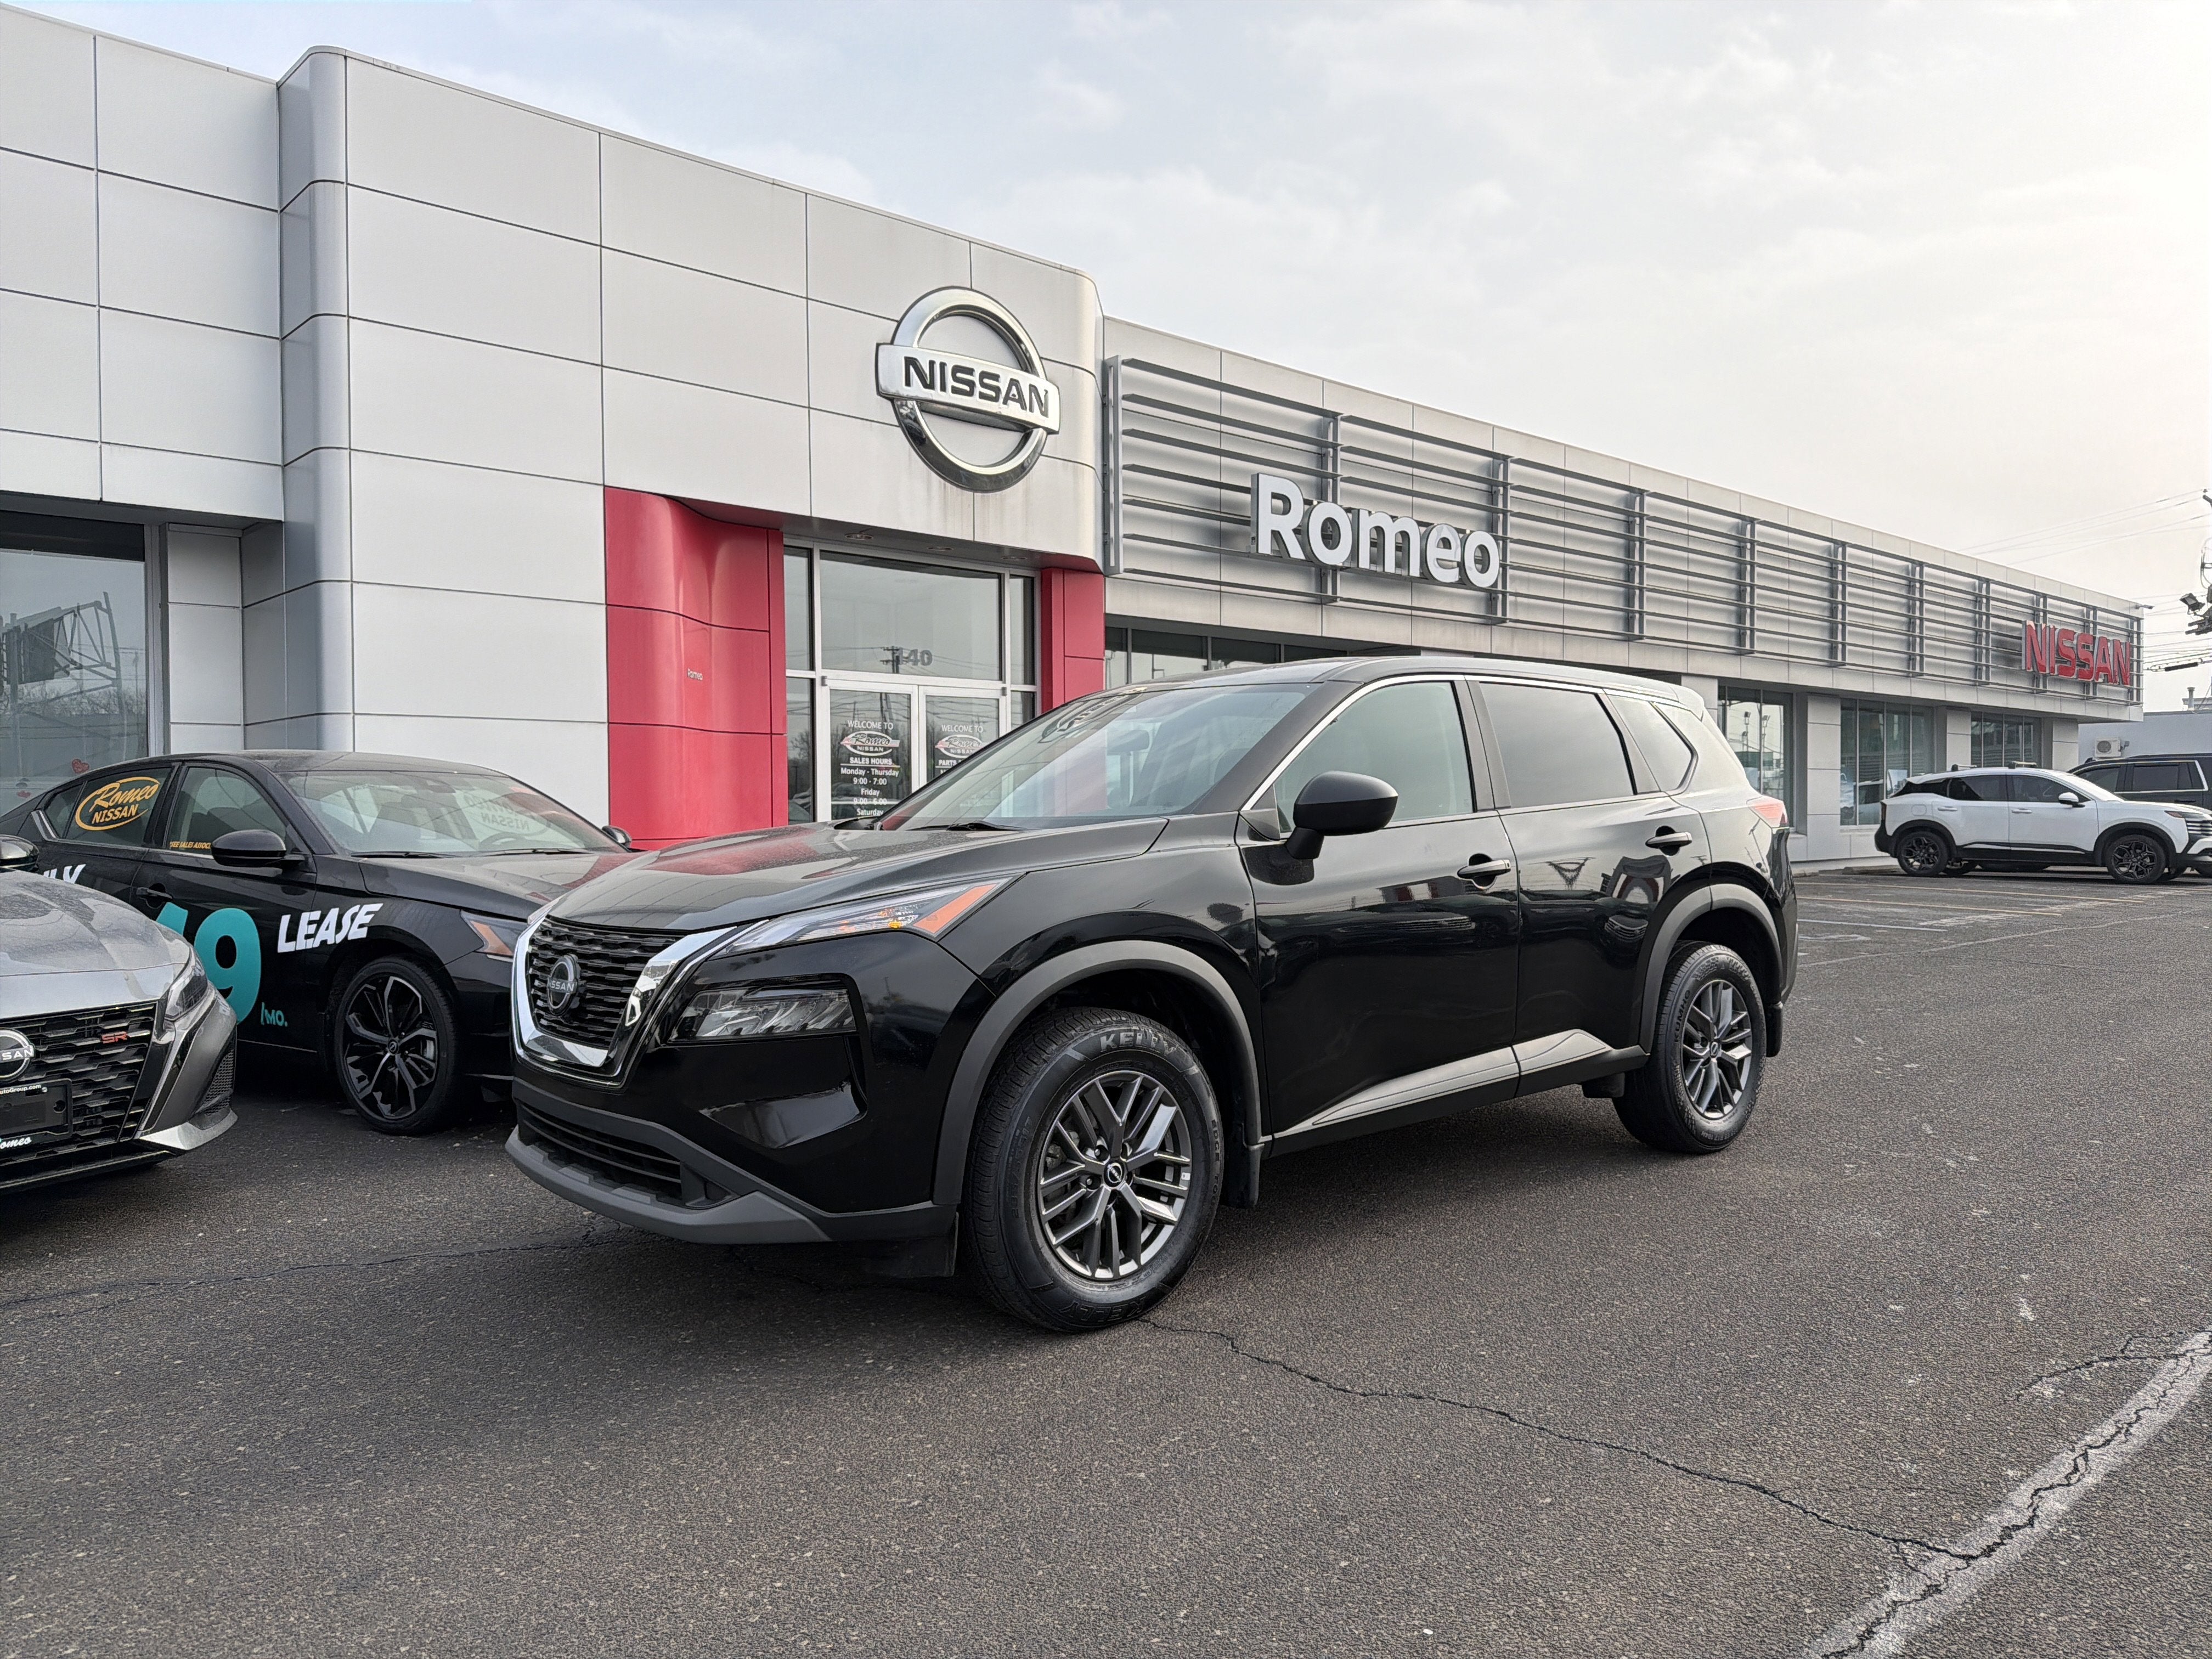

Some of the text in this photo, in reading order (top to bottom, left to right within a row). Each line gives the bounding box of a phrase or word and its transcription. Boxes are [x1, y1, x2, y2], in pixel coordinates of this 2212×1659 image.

[904, 356, 1049, 418] NISSAN
[1251, 472, 1500, 588] Romeo
[896, 647, 933, 666] 140
[2023, 620, 2131, 686] NISSAN
[847, 720, 882, 729] WELCOME
[941, 725, 973, 733] WELCOME
[853, 733, 891, 746] Romeo
[945, 736, 980, 747] Romeo
[840, 768, 866, 776] Monday
[871, 768, 899, 777] Thursday
[89, 782, 160, 812] Romeo
[92, 804, 139, 825] NISSAN
[277, 903, 383, 953] LEASE
[1673, 989, 1690, 1043] KUMHO
[101, 1031, 128, 1043] SR
[0, 1137, 32, 1149] omeo
